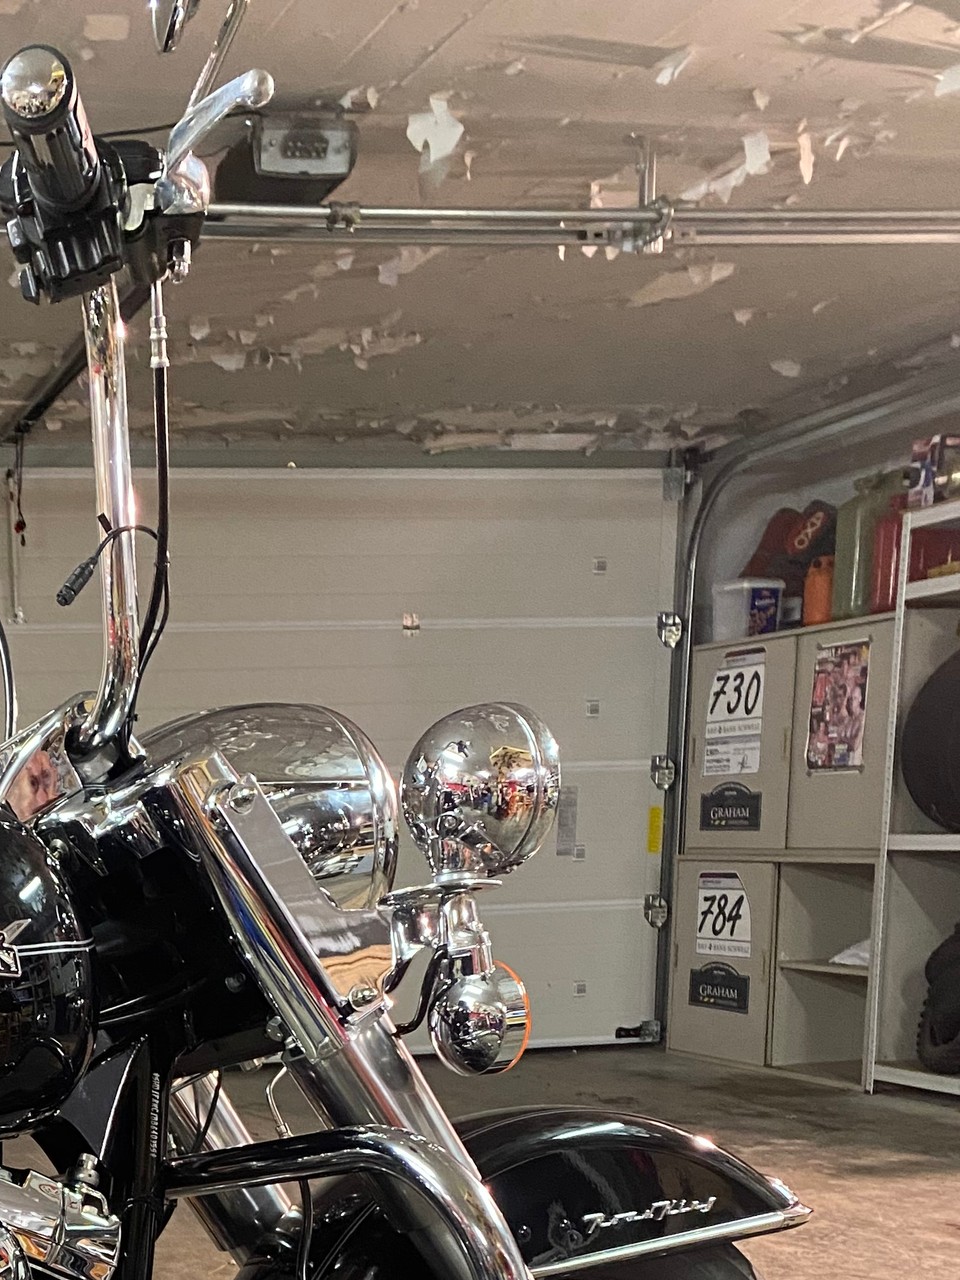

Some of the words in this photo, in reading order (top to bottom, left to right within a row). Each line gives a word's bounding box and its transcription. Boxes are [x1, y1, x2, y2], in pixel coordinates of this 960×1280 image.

[710, 670, 762, 716] 730
[710, 807, 749, 820] GRAHAM
[698, 893, 745, 936] 784
[700, 983, 738, 999] GRAHAM
